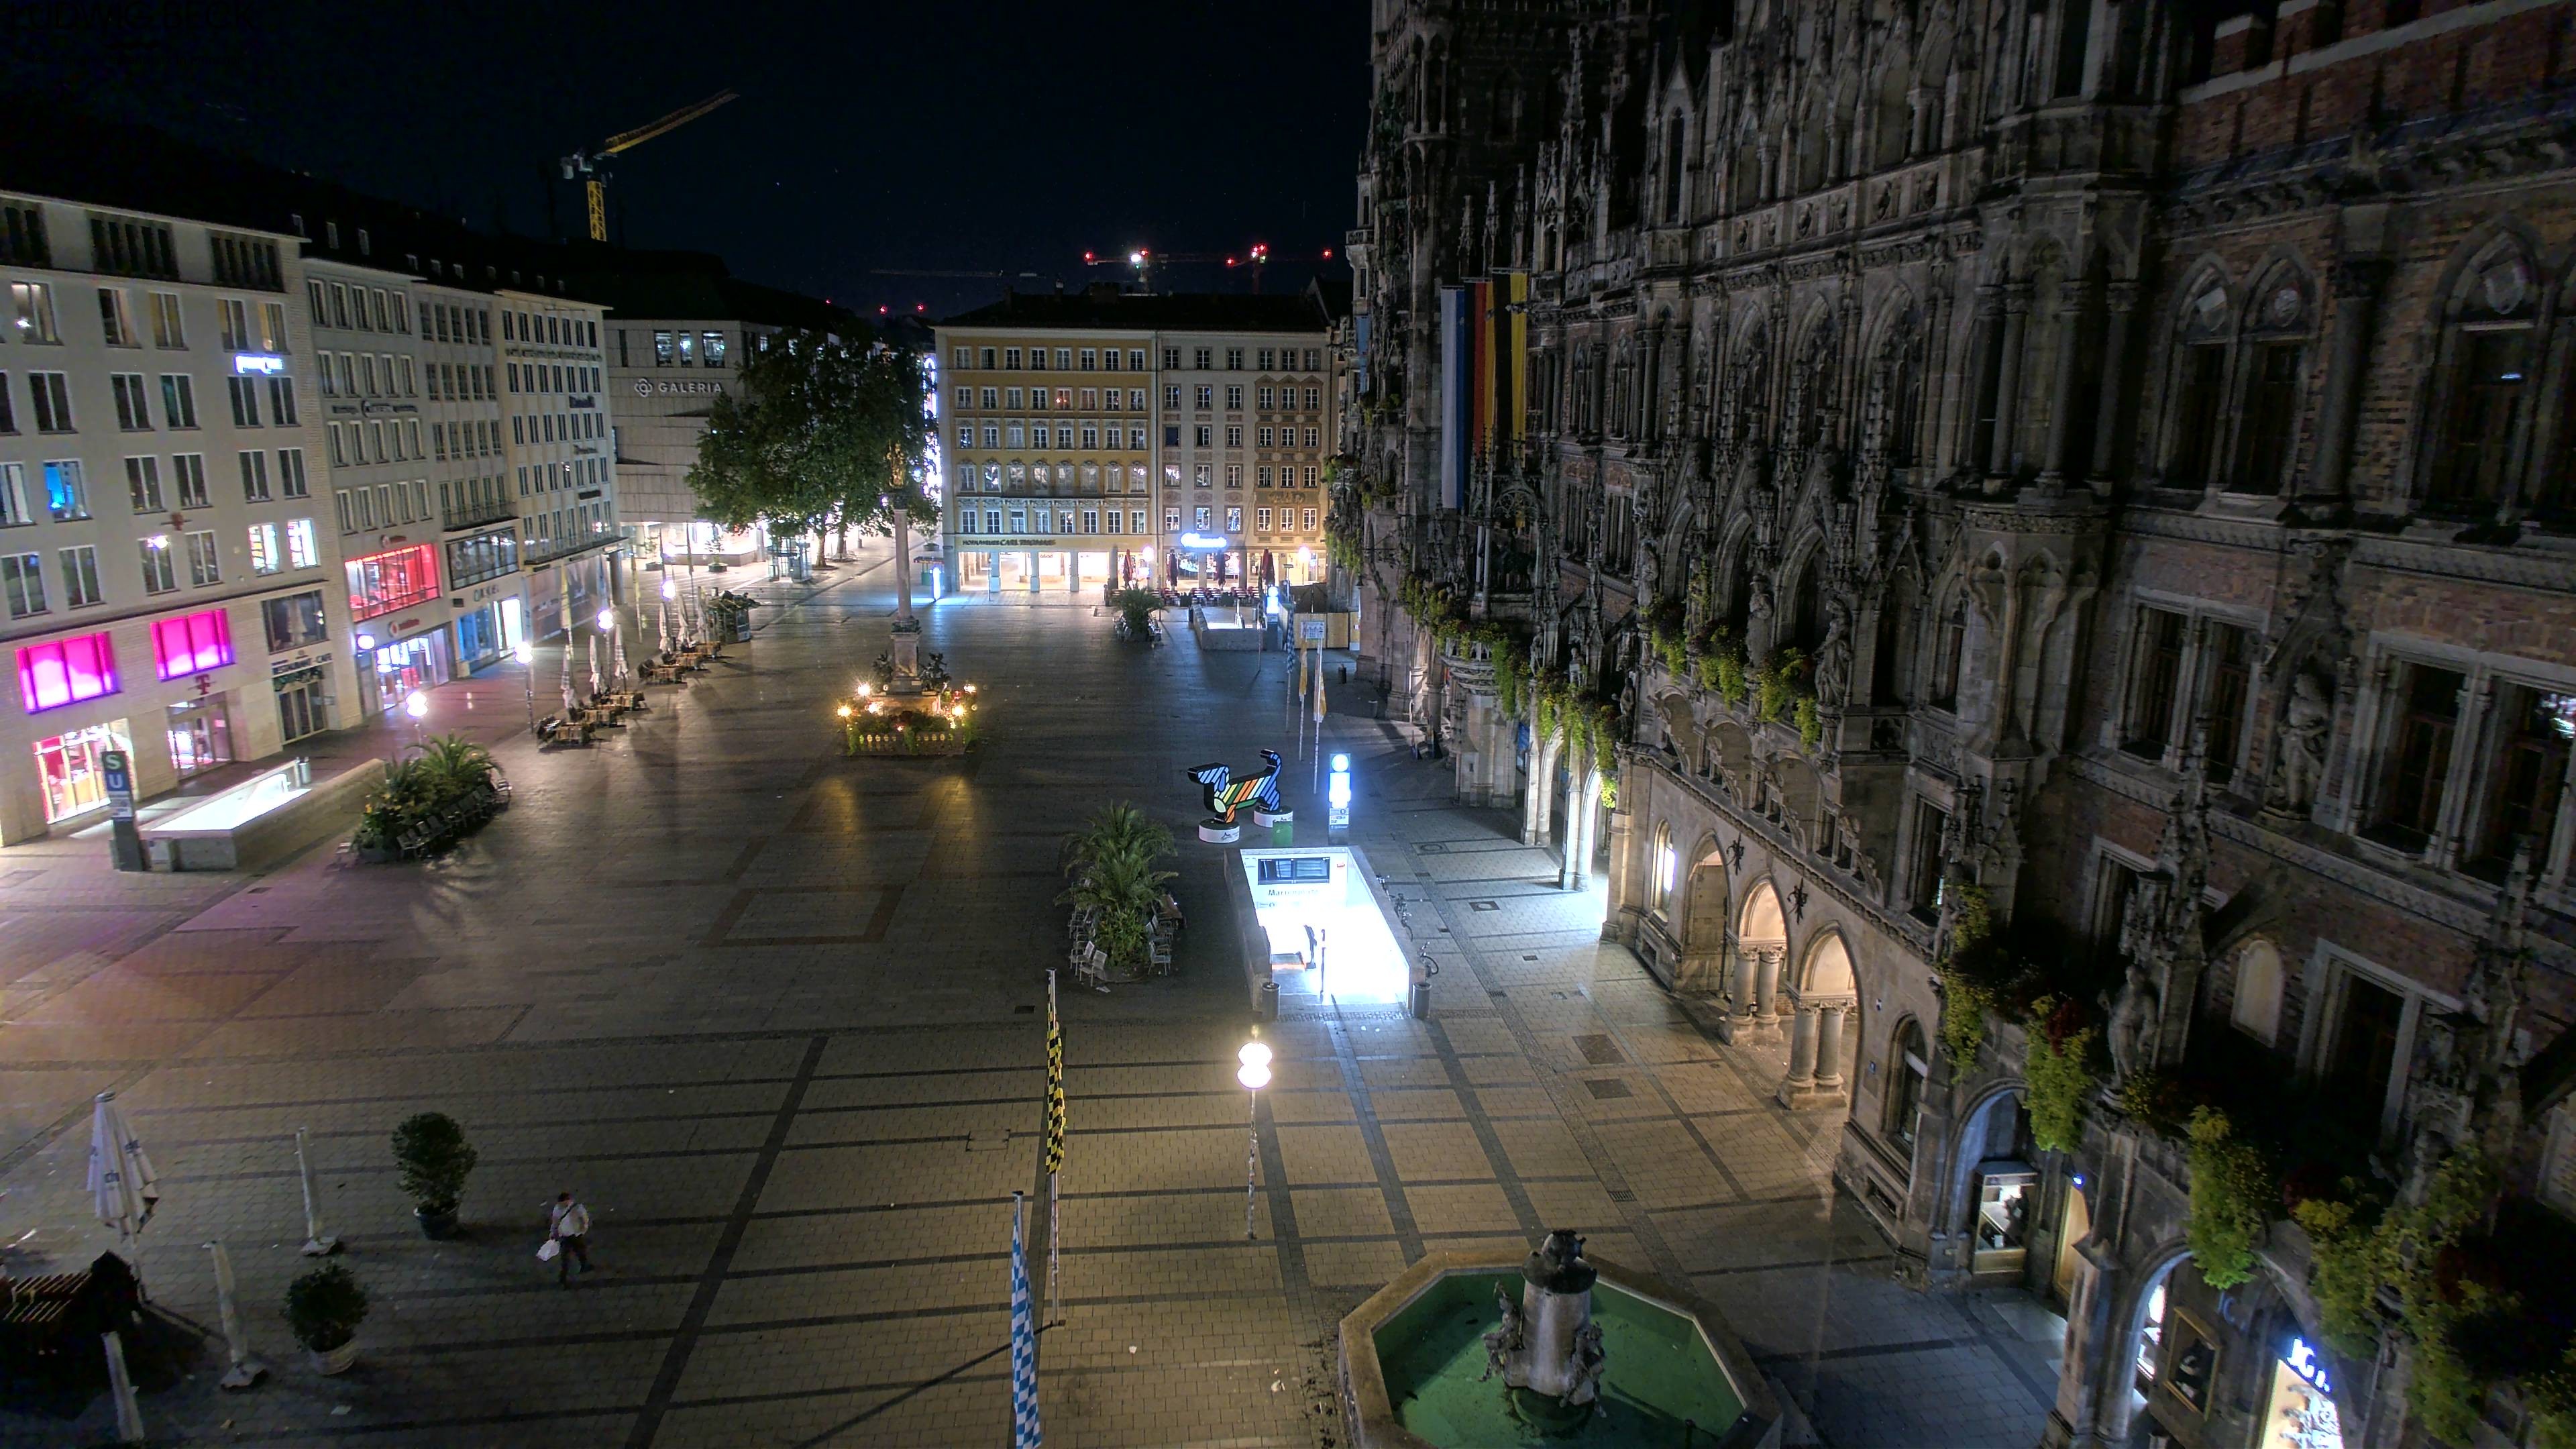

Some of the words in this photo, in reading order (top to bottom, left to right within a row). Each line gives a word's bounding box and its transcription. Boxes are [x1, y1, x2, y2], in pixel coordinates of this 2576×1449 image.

[659, 382, 722, 393] GALERIA
[105, 754, 121, 769] S
[109, 773, 123, 788] U
